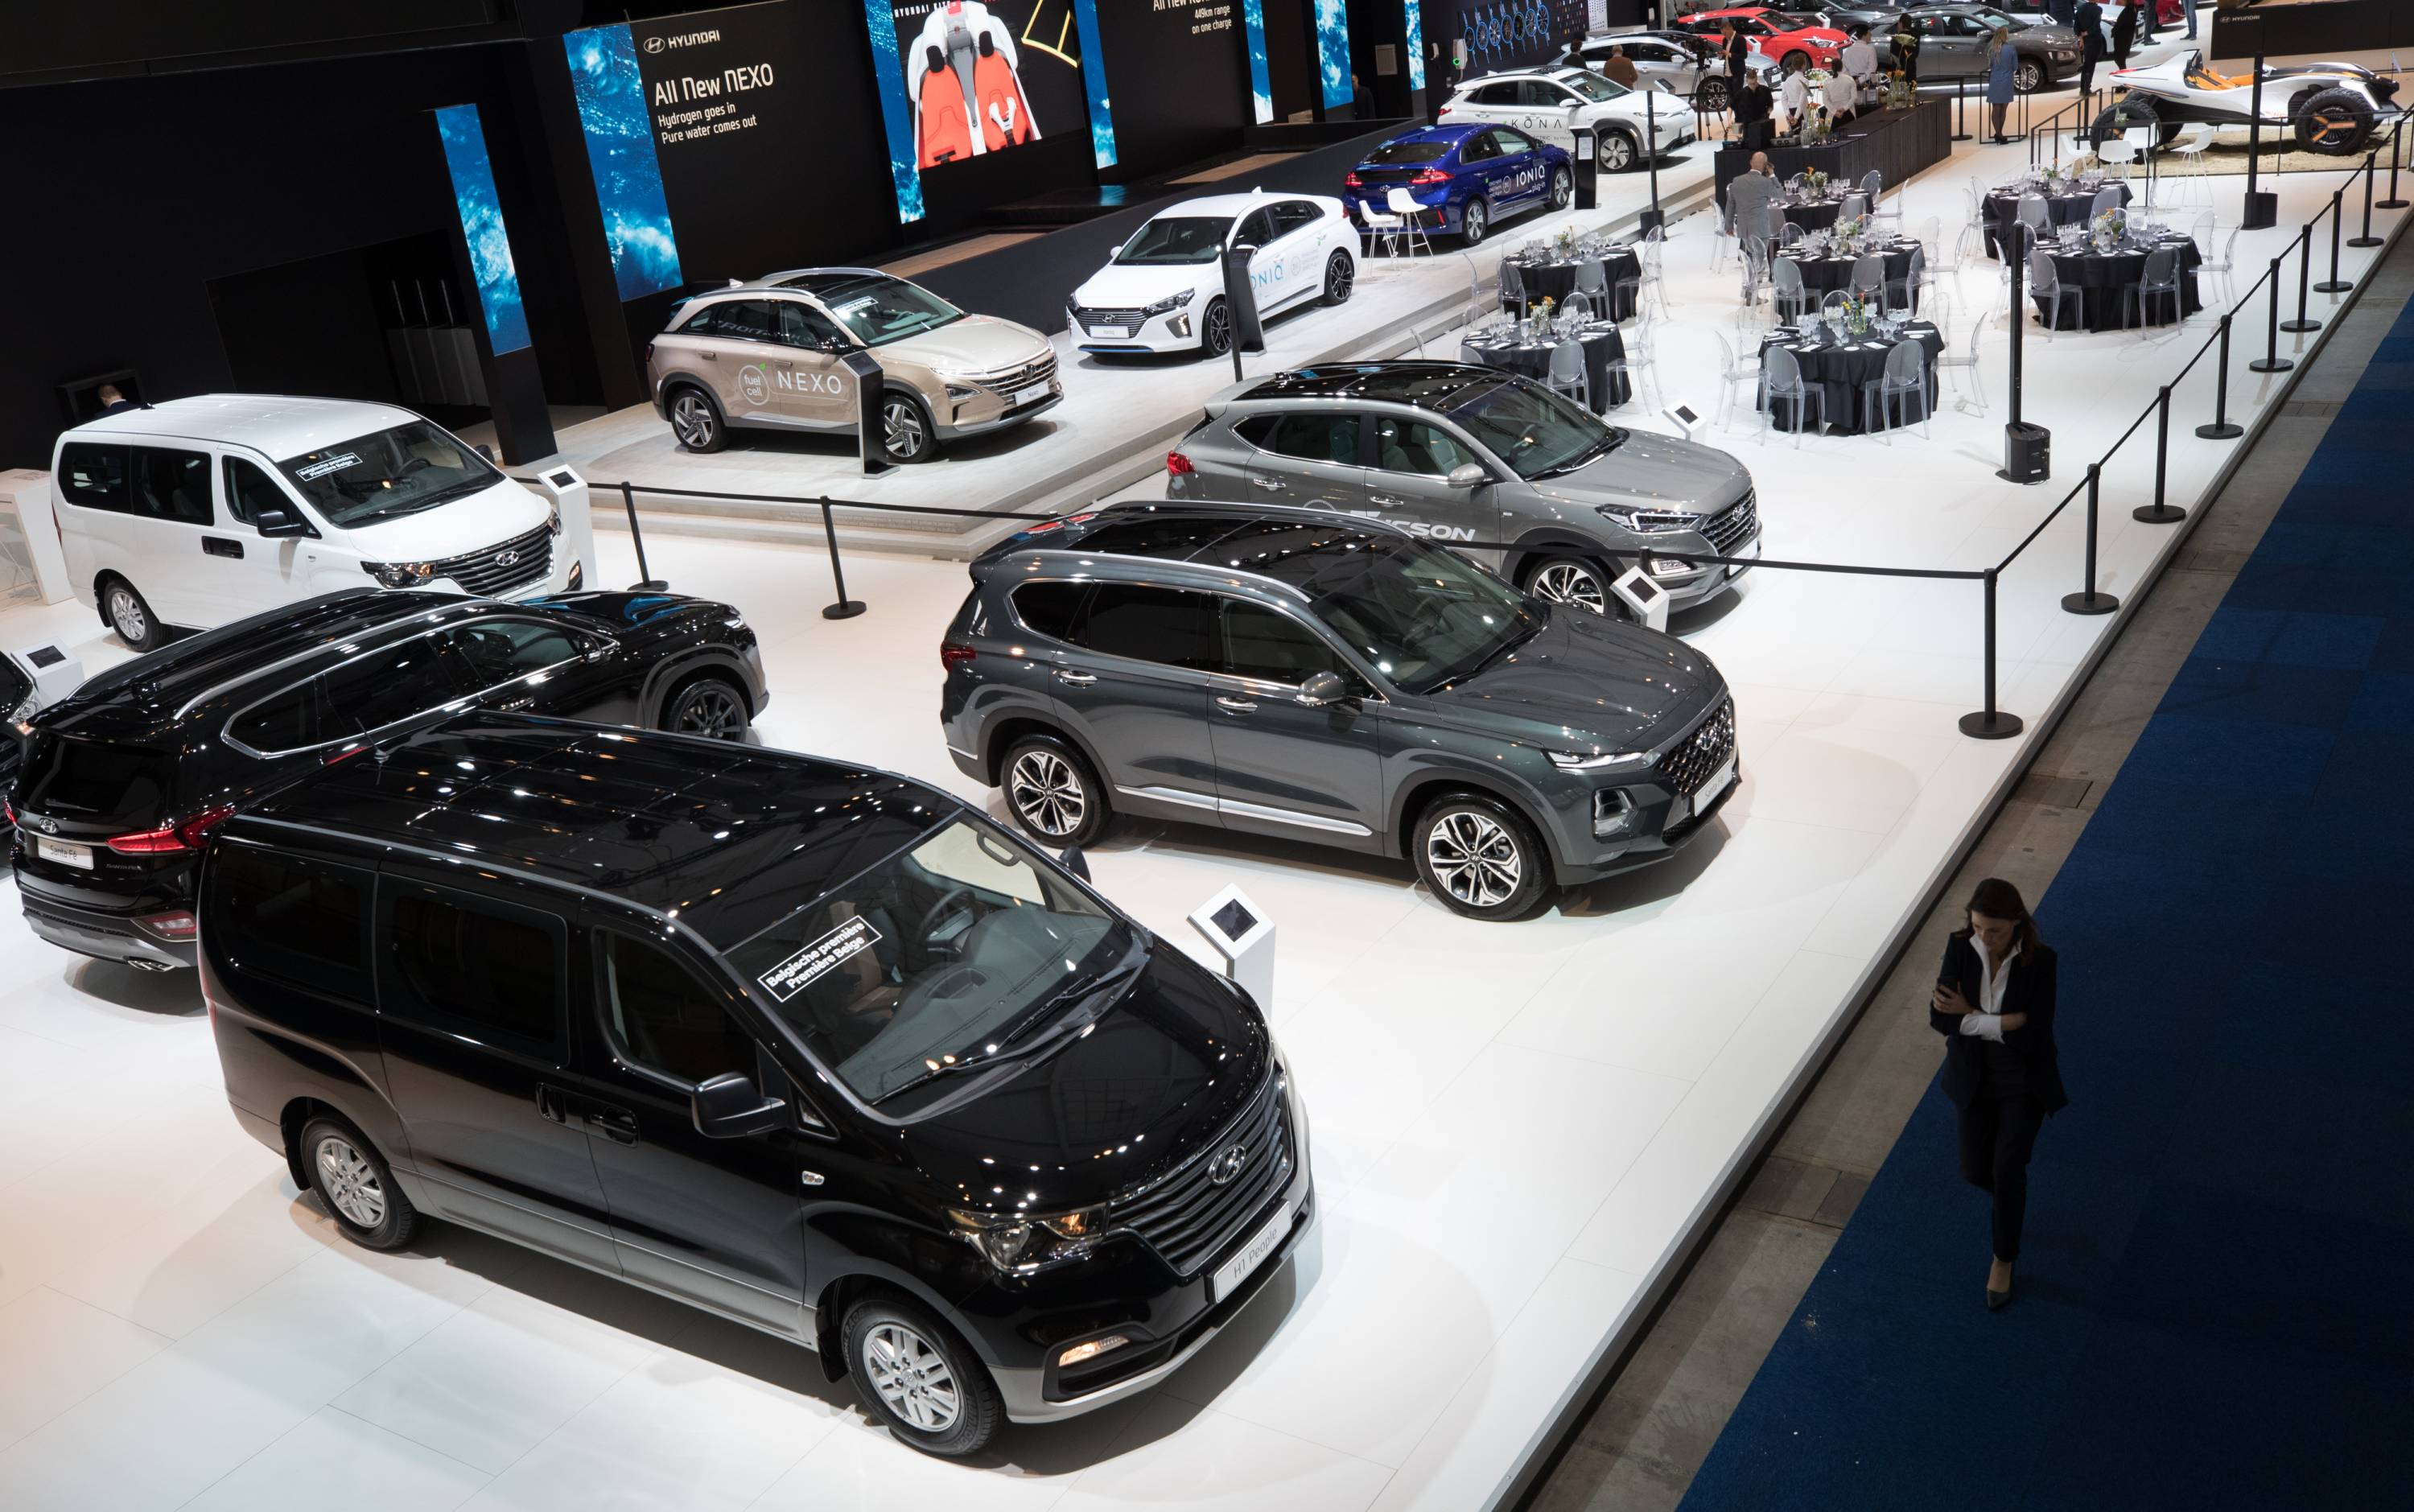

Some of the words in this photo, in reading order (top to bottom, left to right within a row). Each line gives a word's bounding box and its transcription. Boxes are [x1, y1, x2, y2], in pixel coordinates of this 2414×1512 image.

[894, 4, 929, 18] HYUNDAI
[1214, 5, 1231, 16] range
[1192, 26, 1200, 34] on
[1201, 23, 1212, 33] one
[1213, 19, 1232, 30] charge
[668, 30, 721, 49] HYUNDAI
[655, 80, 679, 106] All
[682, 76, 720, 101] New
[724, 63, 774, 93] NEXO
[658, 110, 702, 130] Hydrogen
[704, 105, 726, 121] goes
[727, 101, 736, 114] in
[661, 131, 684, 145] Pure
[686, 125, 711, 141] water
[713, 120, 740, 134] comes
[743, 113, 758, 127] out
[1516, 164, 1545, 187] IONIQ
[1531, 181, 1546, 193] plug-in
[1250, 265, 1283, 290] ONIQ
[744, 374, 761, 386] fuel
[777, 370, 842, 394] NEXO
[747, 387, 763, 397] cell
[50, 845, 68, 859] Santa
[765, 950, 820, 988] Belgische
[818, 922, 866, 956] première
[785, 954, 837, 990] Première
[832, 936, 866, 959] Belge
[1234, 1259, 1246, 1279] H1
[1248, 1228, 1278, 1263] People
